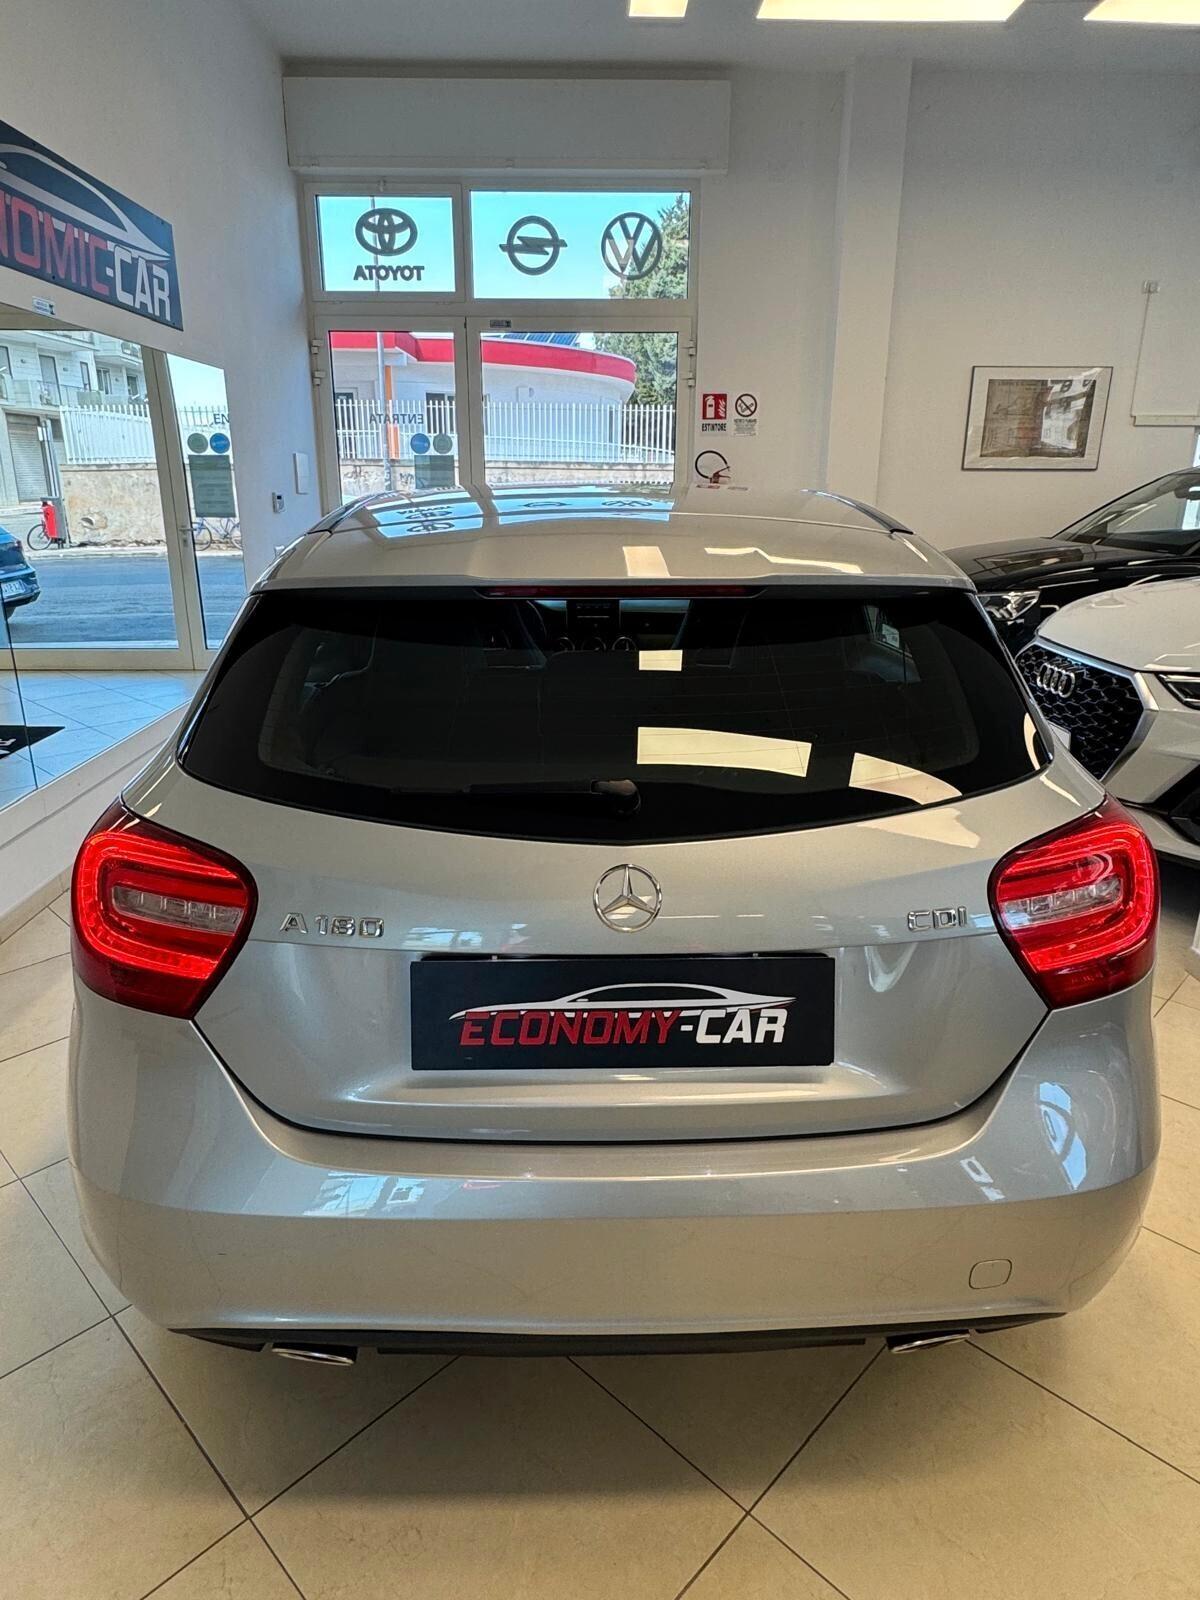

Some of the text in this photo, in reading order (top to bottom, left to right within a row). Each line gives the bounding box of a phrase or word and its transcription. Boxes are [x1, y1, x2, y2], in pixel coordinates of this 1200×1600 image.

[701, 423, 727, 432] ESTINTORE
[279, 912, 385, 938] A 180
[907, 905, 968, 932] CDI
[459, 1007, 789, 1046] ECONOMY-CAR
